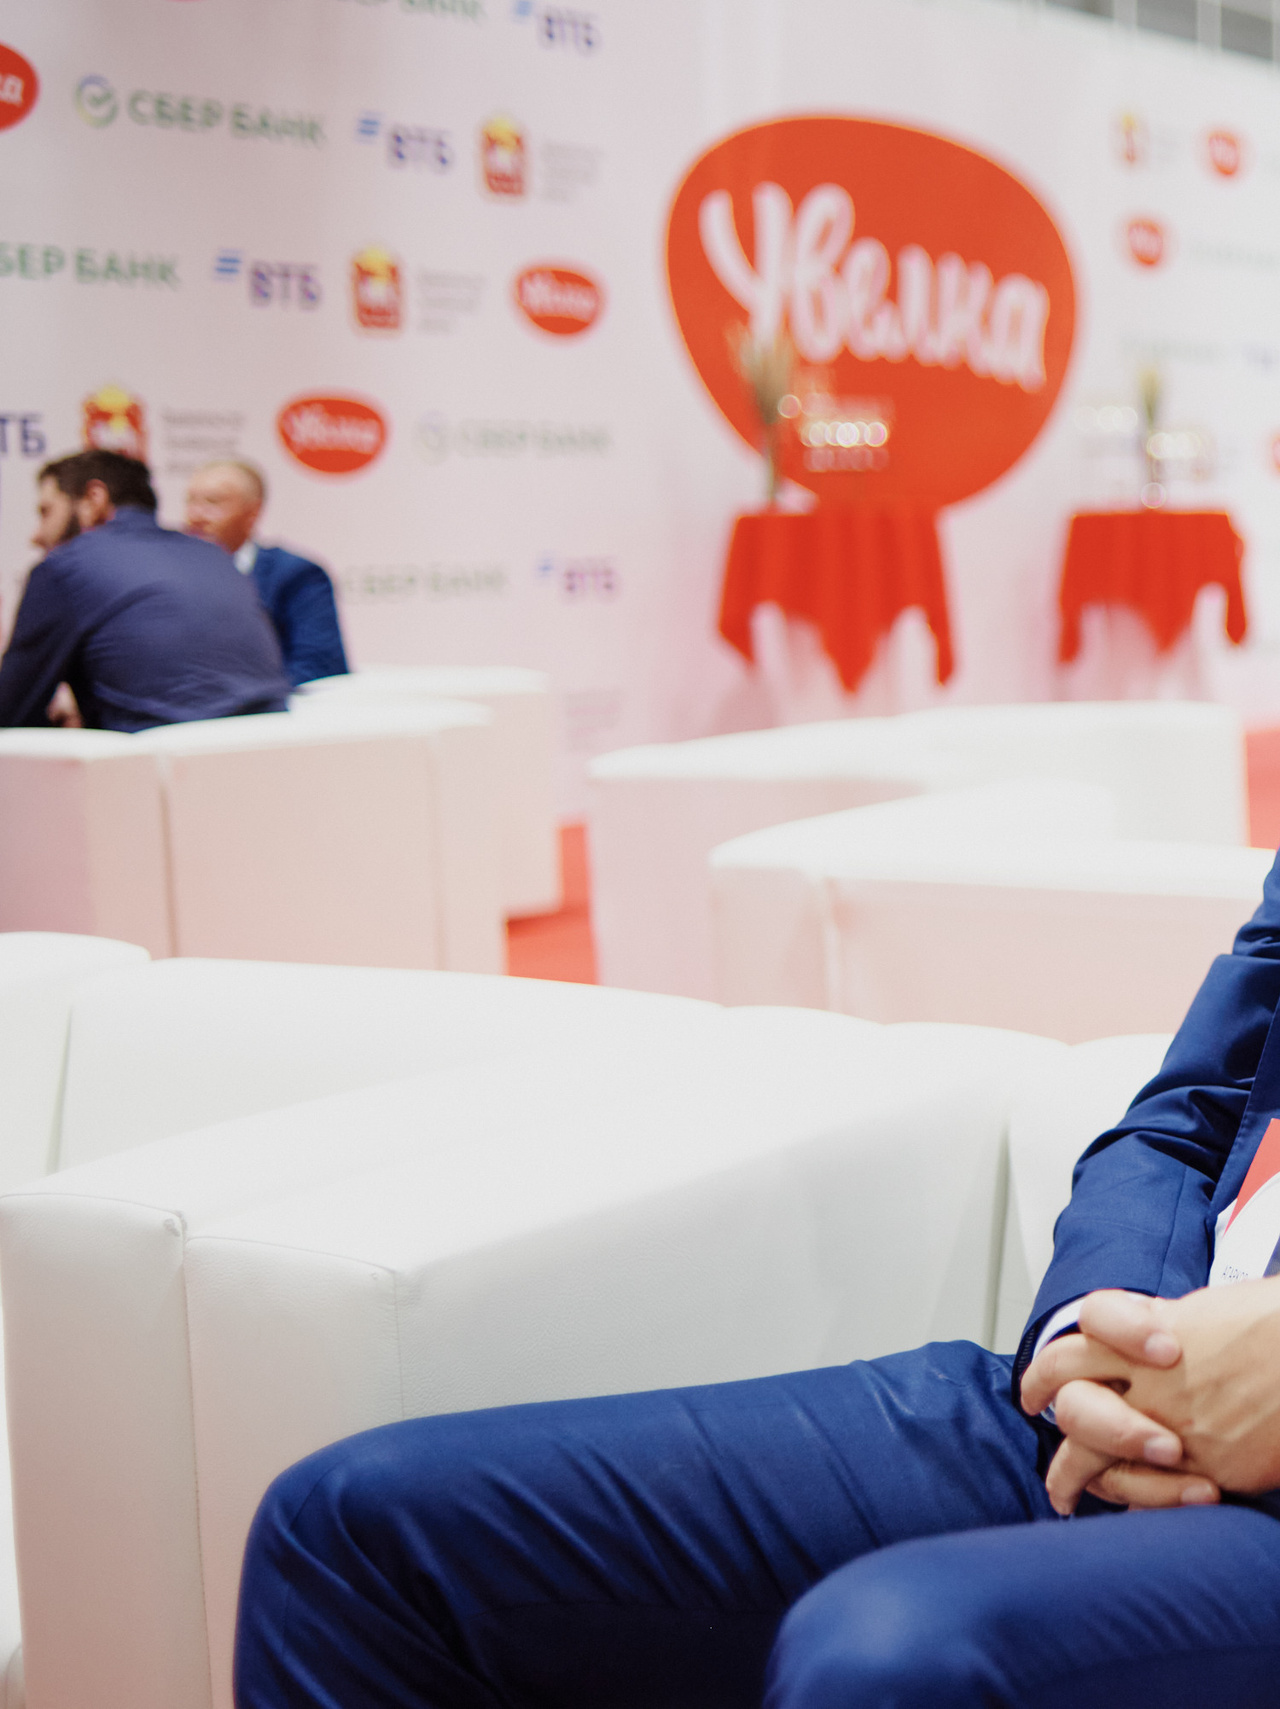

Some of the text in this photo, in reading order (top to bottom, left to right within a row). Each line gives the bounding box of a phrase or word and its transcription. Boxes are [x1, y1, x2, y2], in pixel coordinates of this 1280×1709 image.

[127, 89, 327, 149] СБЕР БАНК
[387, 122, 456, 173] ВТБ
[74, 247, 182, 291] БАНК
[248, 258, 323, 312] ВТБ
[699, 180, 1050, 393] Увелка
